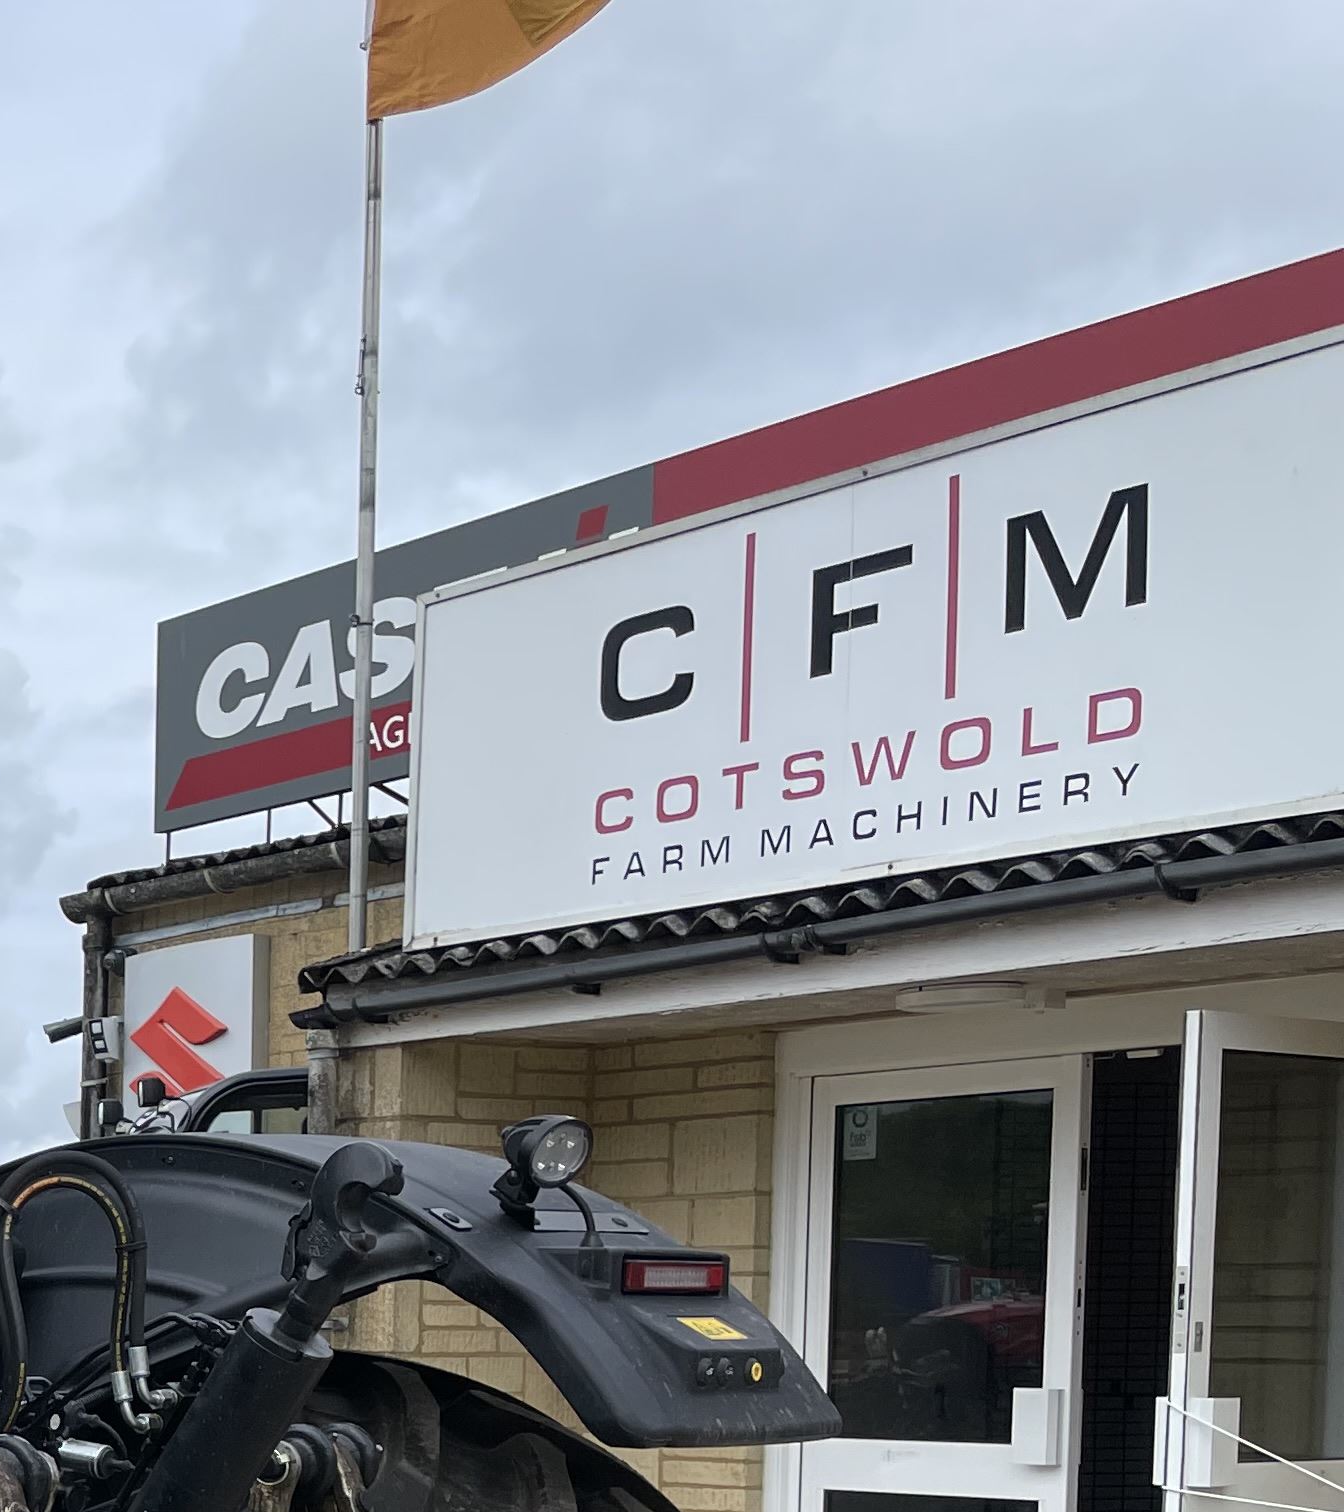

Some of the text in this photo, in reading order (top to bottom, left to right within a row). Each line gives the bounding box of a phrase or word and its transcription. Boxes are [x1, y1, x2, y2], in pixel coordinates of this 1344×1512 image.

[599, 483, 1149, 722] C F M
[590, 762, 1142, 887] FARM MACHINERY
[593, 687, 1144, 835] COTSWOLD
